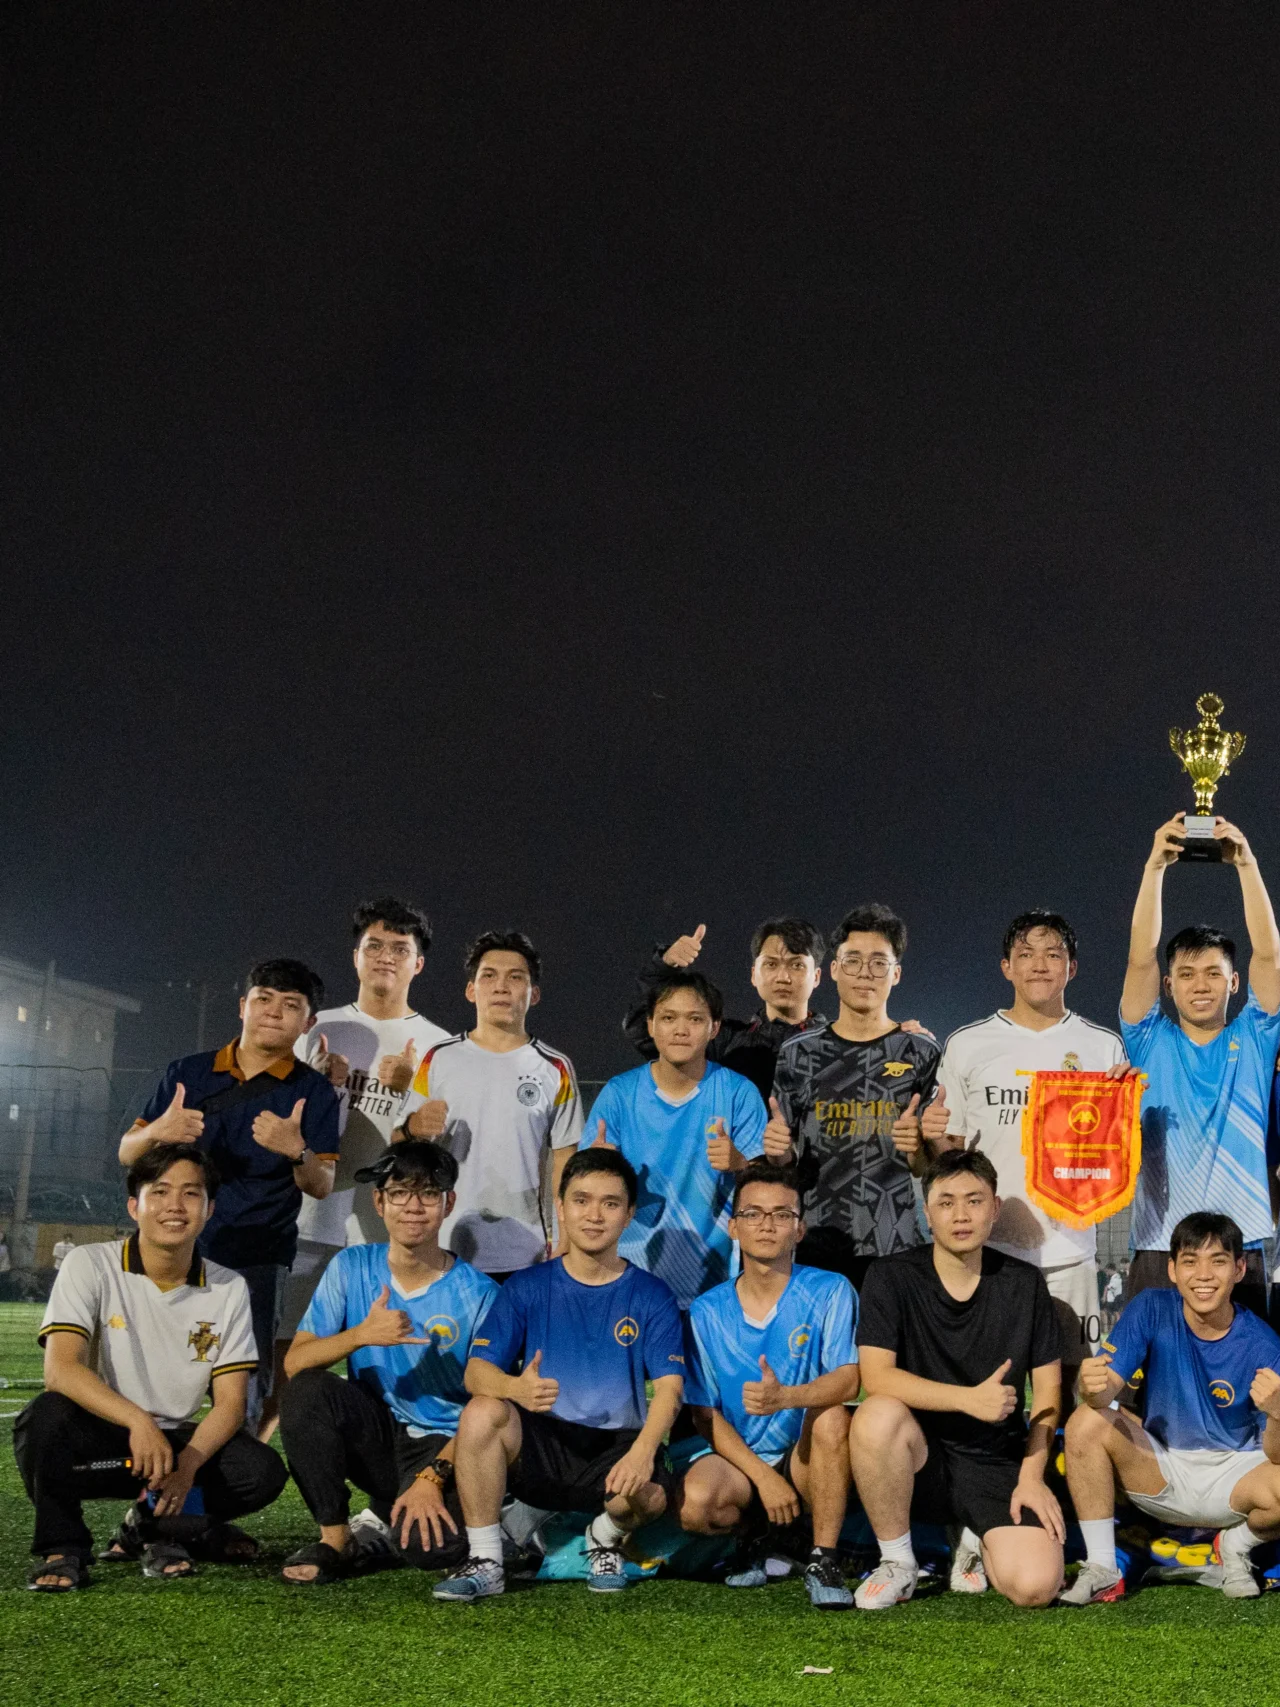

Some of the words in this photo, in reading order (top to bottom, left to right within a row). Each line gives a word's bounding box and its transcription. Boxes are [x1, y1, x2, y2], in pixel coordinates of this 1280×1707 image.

[348, 1094, 393, 1117] BETTER
[985, 1085, 1029, 1106] Emi
[815, 1099, 900, 1120] Emirate
[998, 1109, 1019, 1125] FLY
[826, 1121, 846, 1137] FLY
[1053, 1167, 1111, 1180] CHAMPION
[1077, 1315, 1101, 1344] 10
